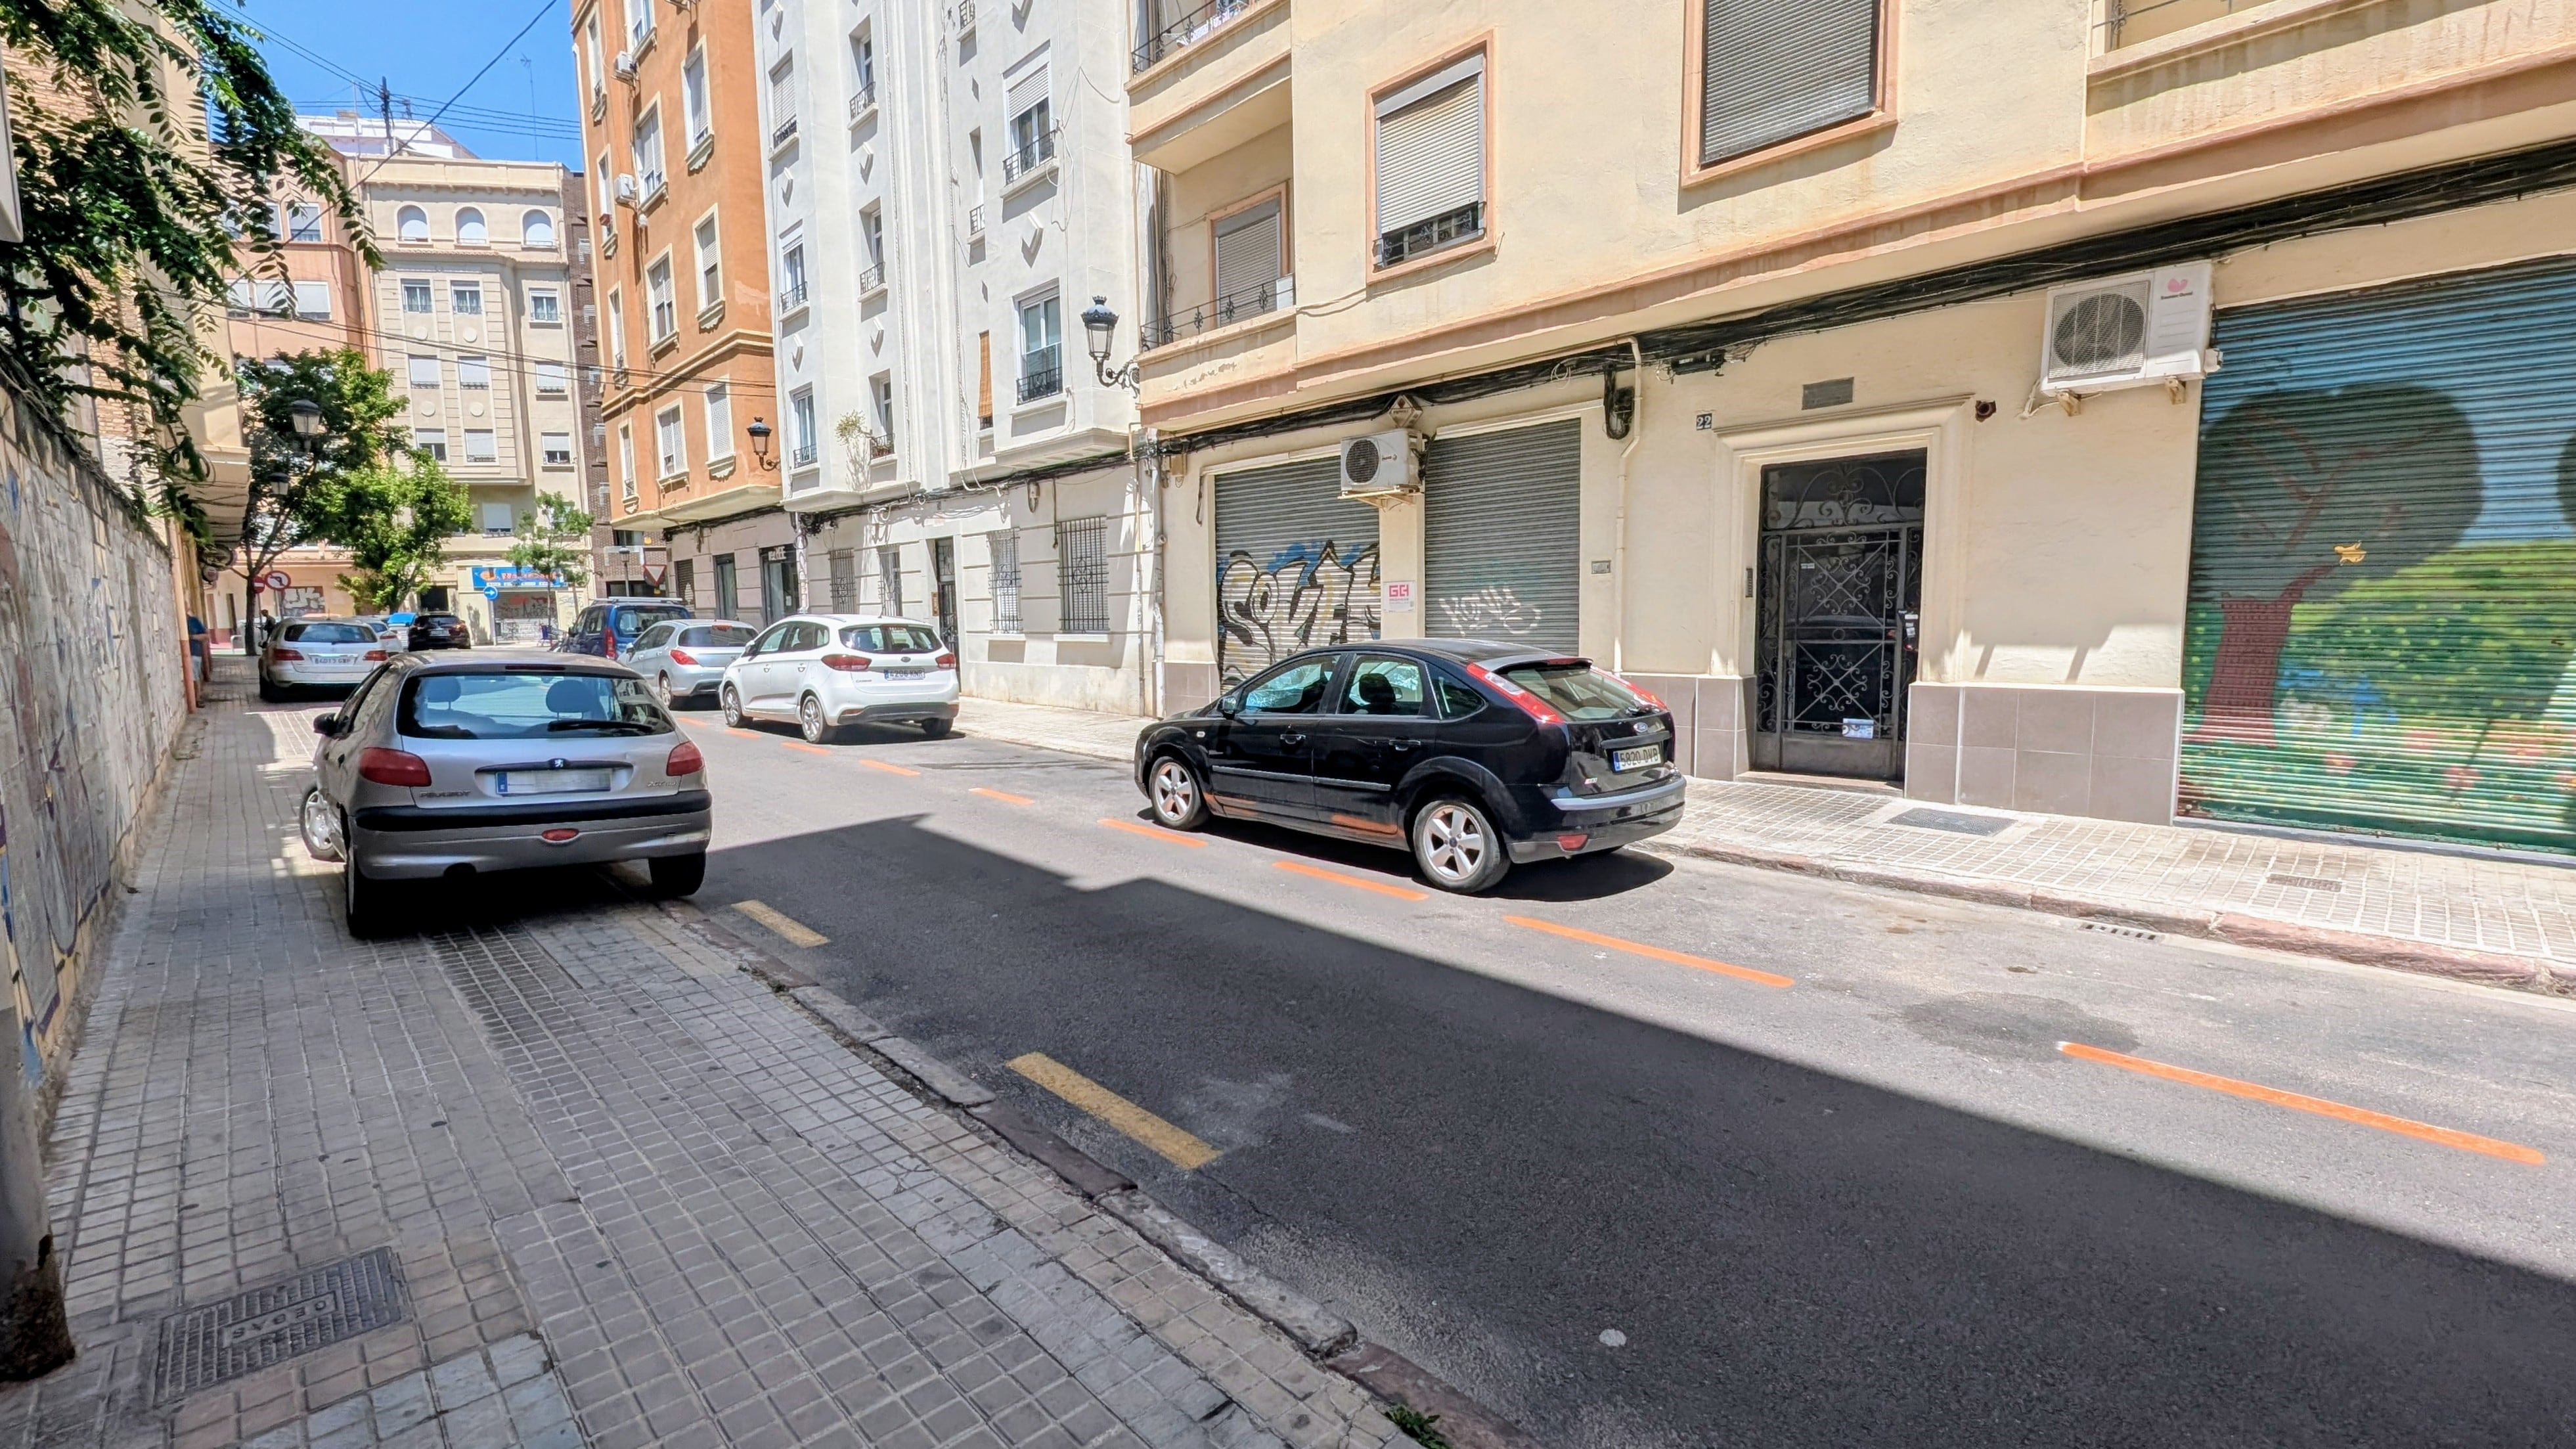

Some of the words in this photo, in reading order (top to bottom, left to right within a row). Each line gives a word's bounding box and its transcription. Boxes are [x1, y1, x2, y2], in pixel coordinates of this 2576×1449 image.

[1697, 415, 1712, 430] 22
[1620, 751, 1641, 767] 5820
[1643, 747, 1659, 763] DVB
